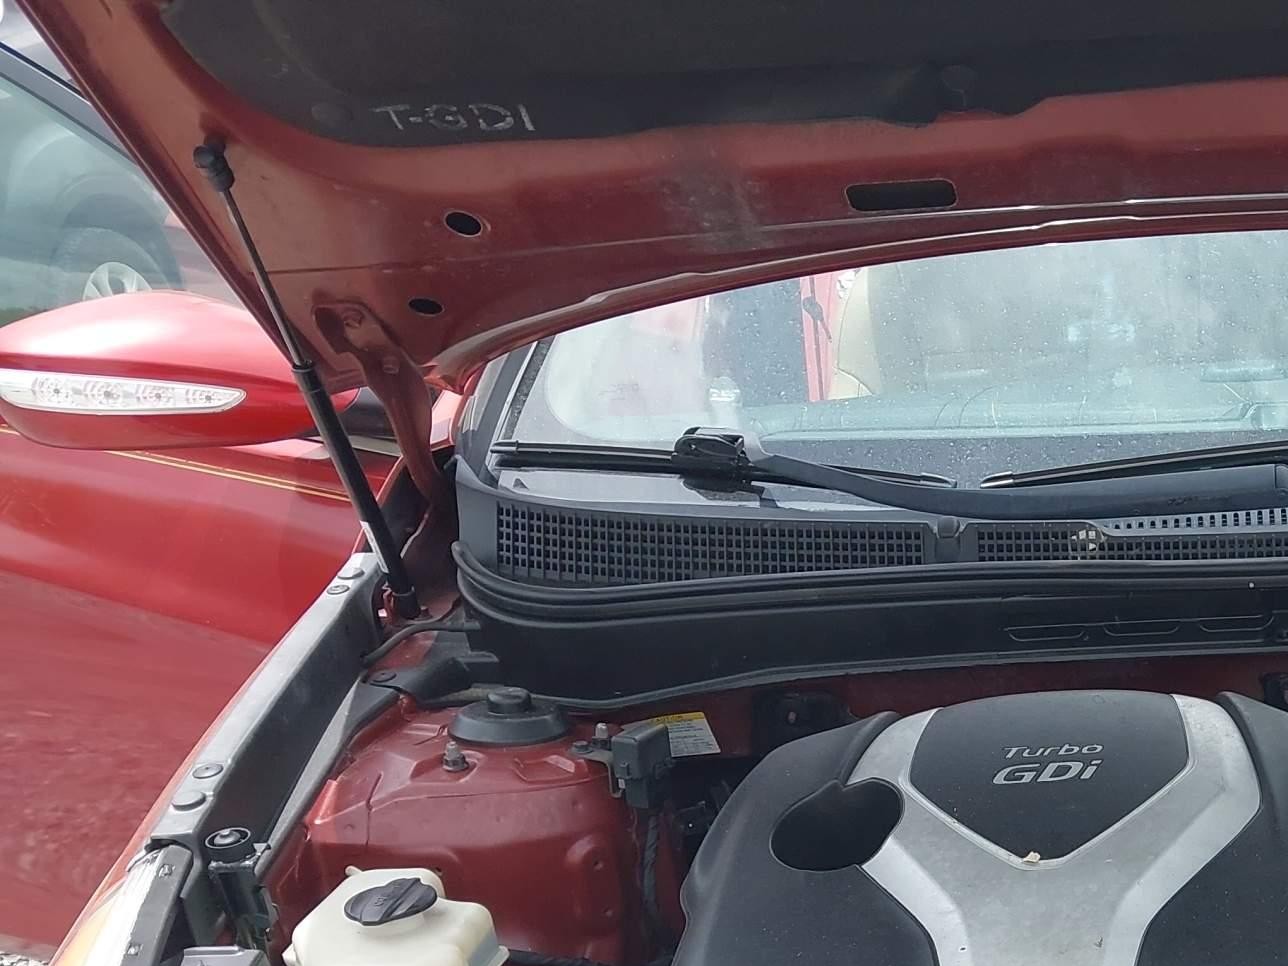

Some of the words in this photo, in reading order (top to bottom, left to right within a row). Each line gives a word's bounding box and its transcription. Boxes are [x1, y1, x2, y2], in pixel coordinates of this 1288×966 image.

[369, 103, 537, 132] T-GDI
[1003, 743, 1104, 759] Turbo
[992, 759, 1103, 785] GDi
